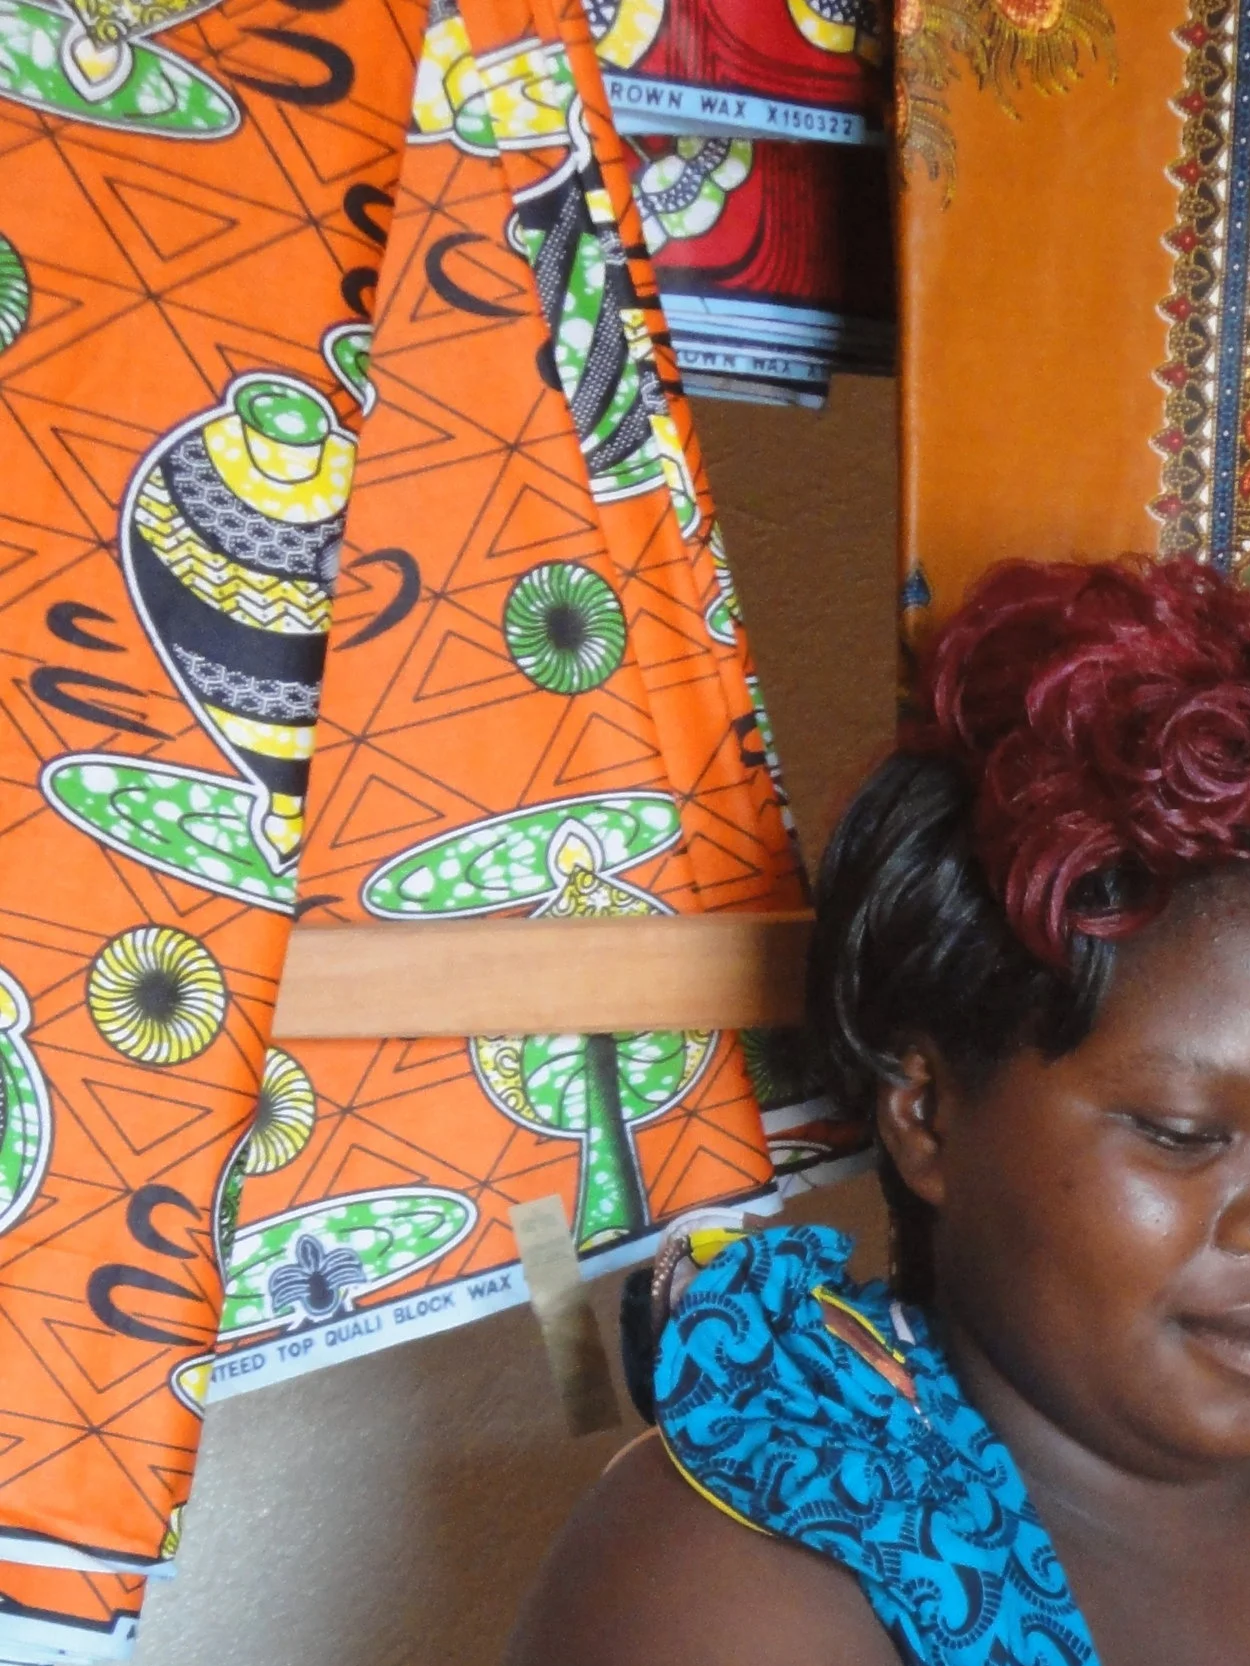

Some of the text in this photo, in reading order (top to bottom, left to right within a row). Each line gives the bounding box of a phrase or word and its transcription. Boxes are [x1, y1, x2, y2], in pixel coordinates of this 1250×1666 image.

[700, 95, 746, 119] WAX
[766, 103, 853, 136] X150322
[680, 349, 735, 368] OWN
[277, 1337, 314, 1363] TOP
[324, 1315, 382, 1347] QUALI
[394, 1290, 456, 1325] BLOCK
[467, 1273, 511, 1301] WAX
